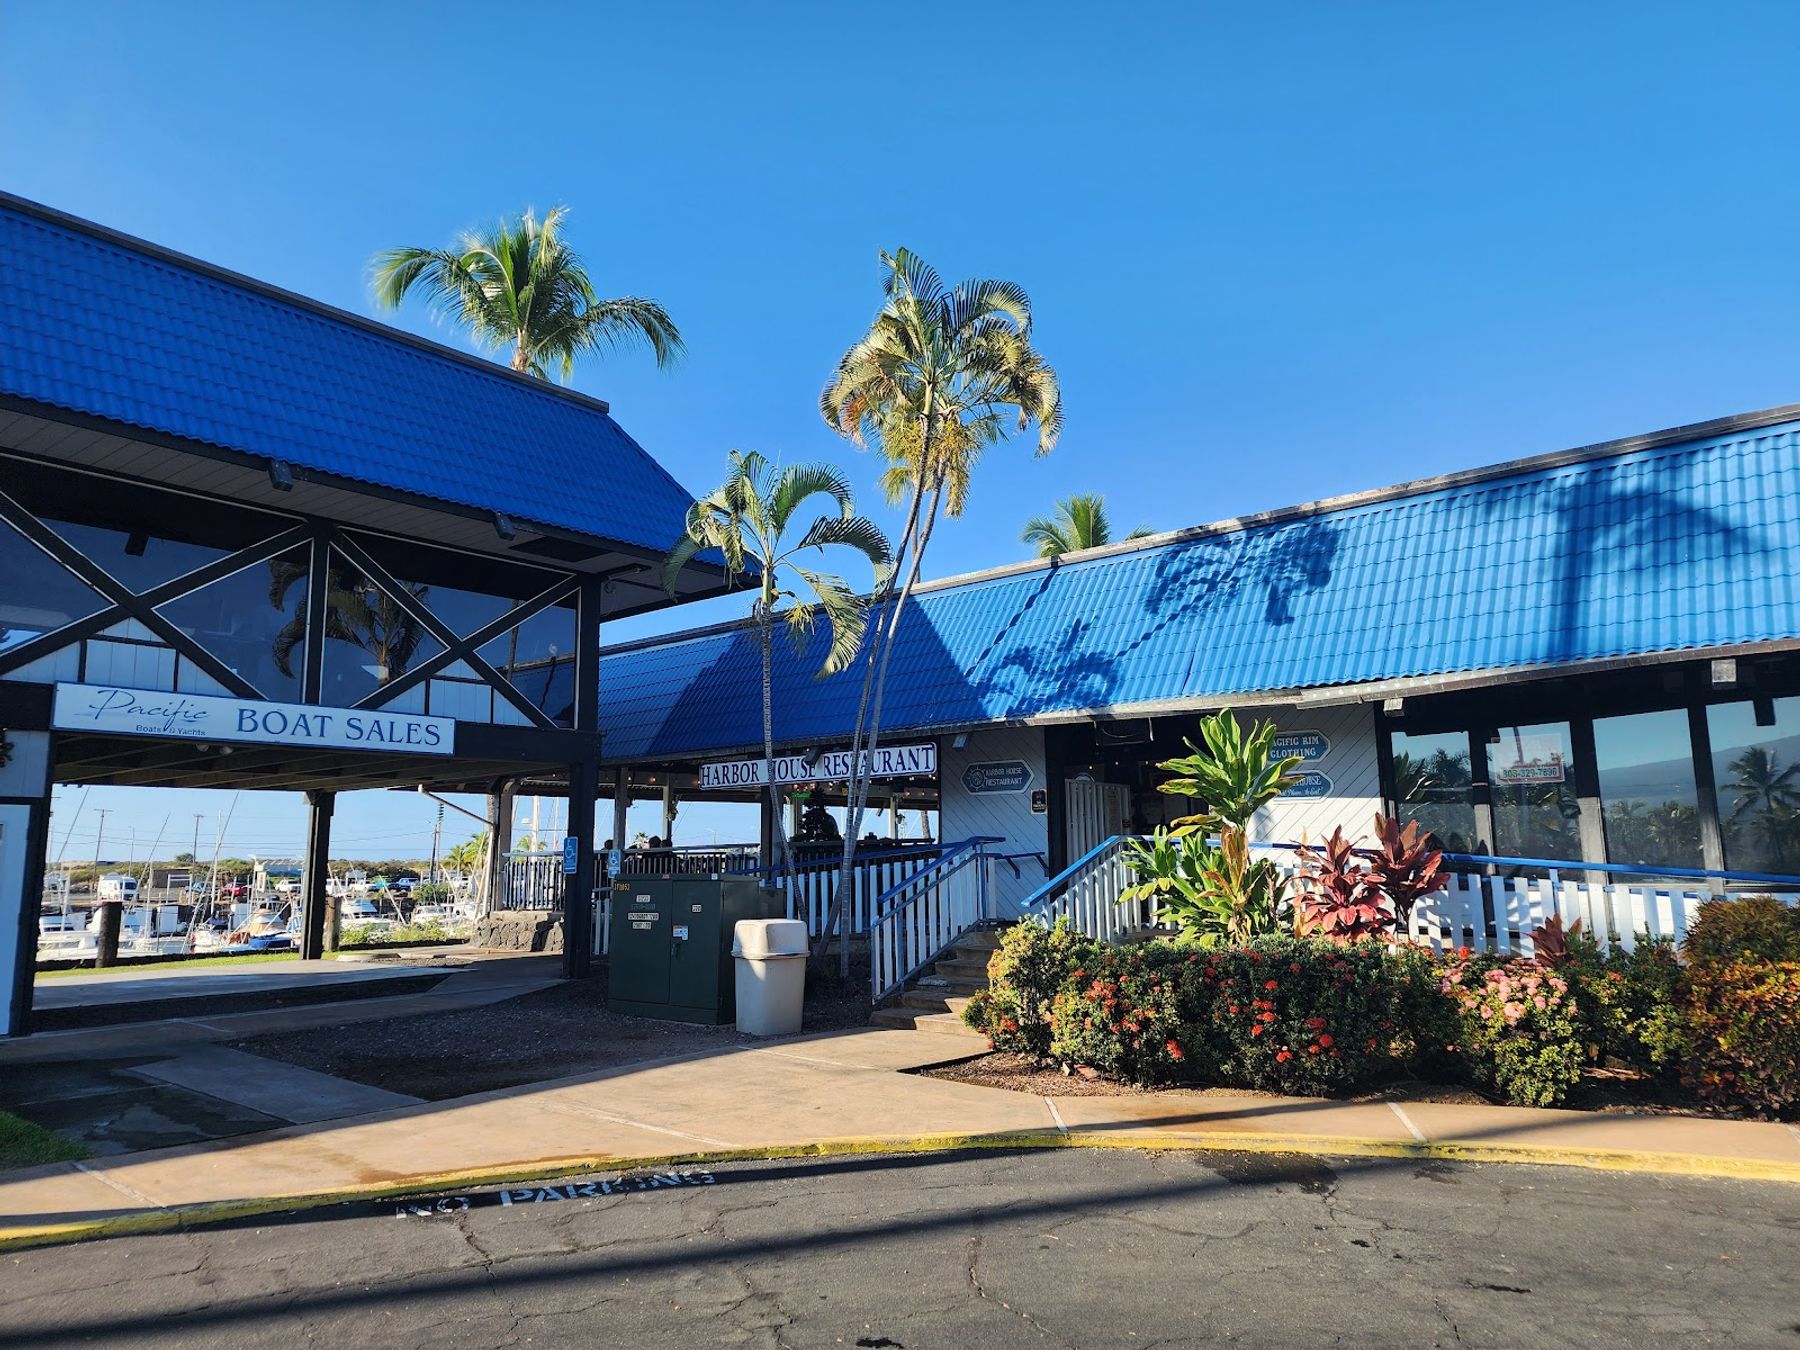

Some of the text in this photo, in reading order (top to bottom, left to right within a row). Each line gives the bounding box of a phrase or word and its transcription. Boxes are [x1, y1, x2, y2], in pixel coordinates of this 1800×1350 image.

[89, 689, 209, 732] Pacific
[136, 724, 162, 733] Boats
[177, 727, 206, 736] Yachts
[236, 707, 441, 746] BOAT SALES
[1270, 747, 1316, 758] CLOTHING
[1302, 736, 1319, 745] RIM
[701, 762, 760, 786] HARBOR
[823, 747, 934, 777] RESAURANT
